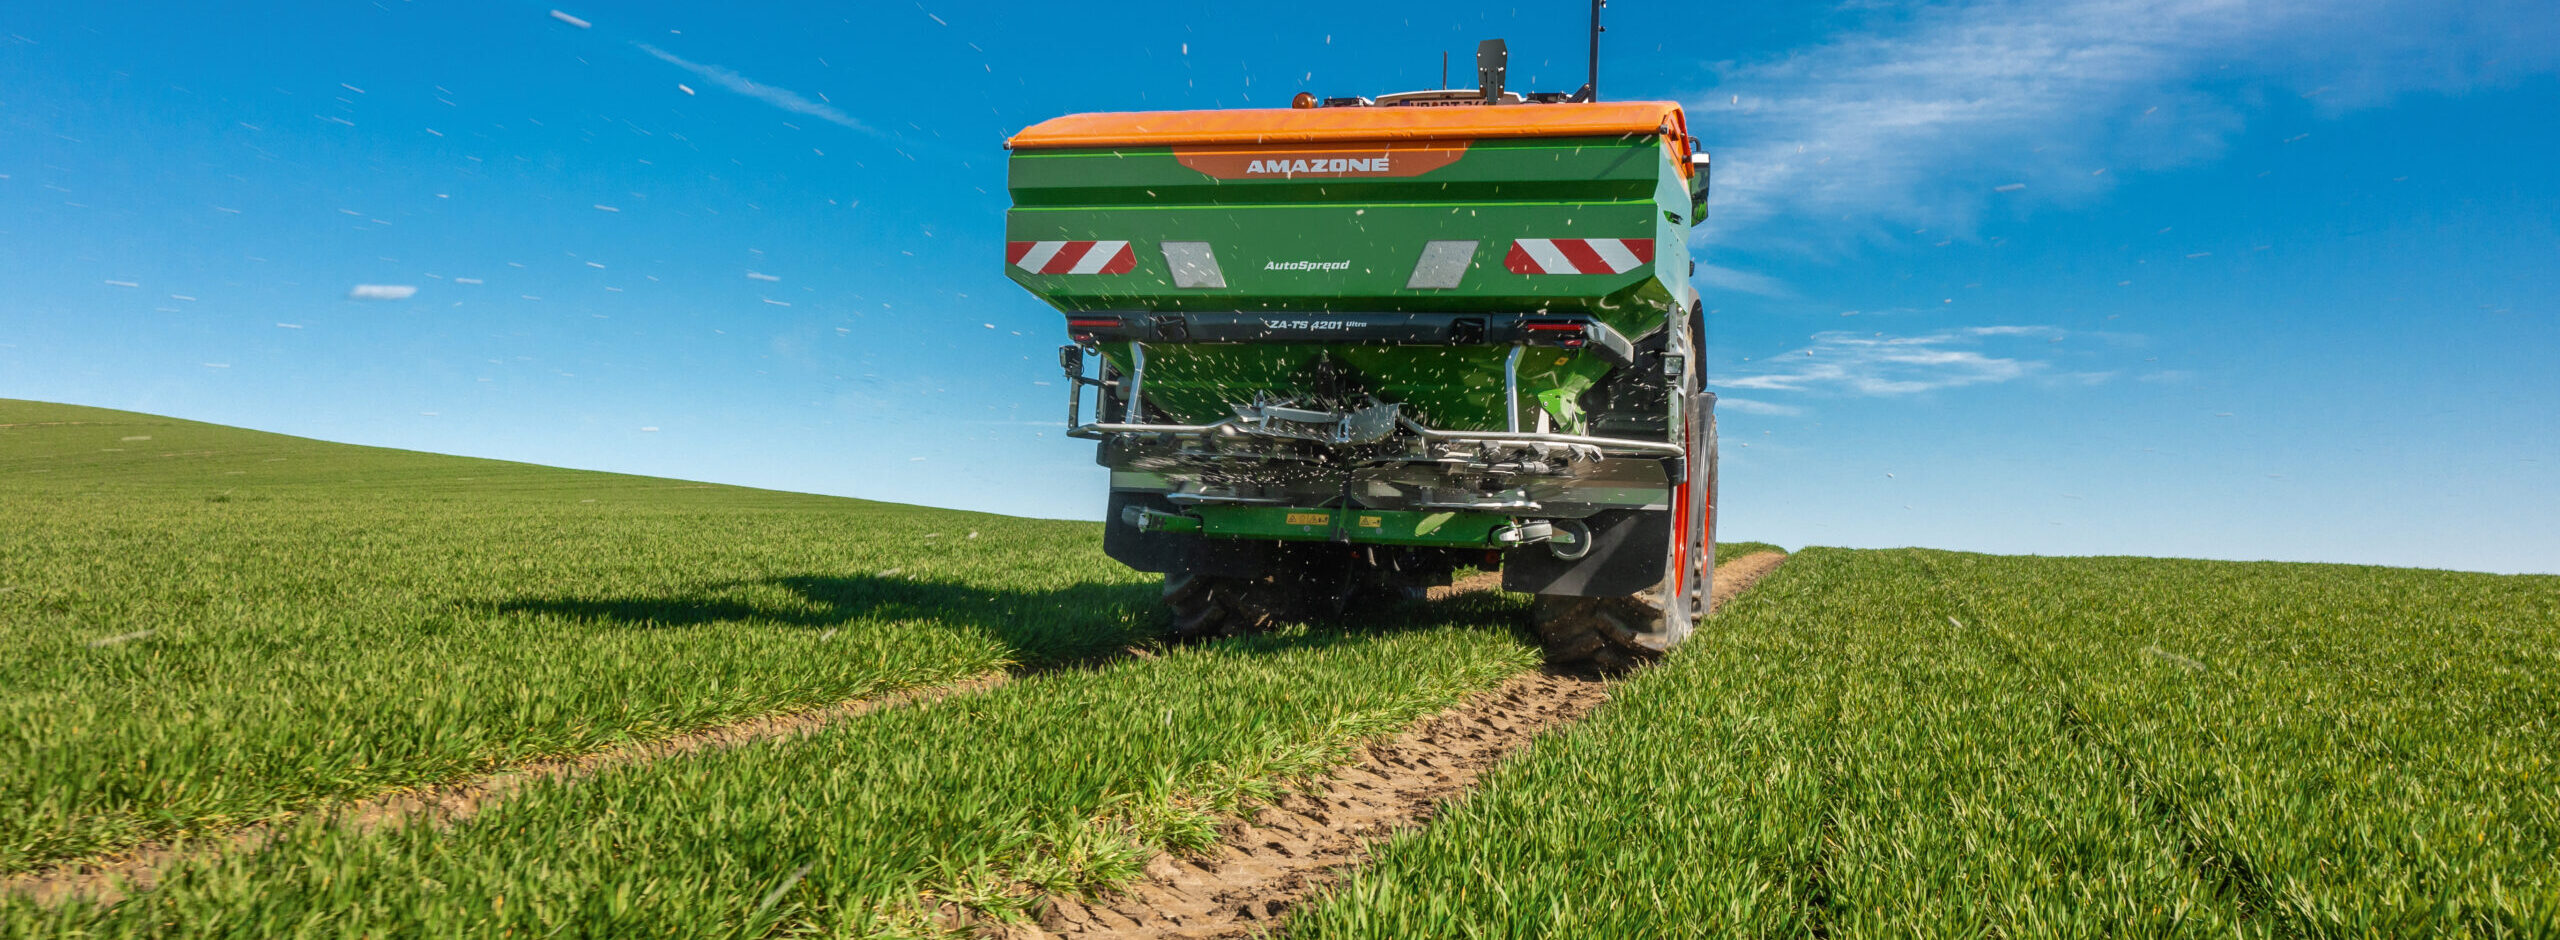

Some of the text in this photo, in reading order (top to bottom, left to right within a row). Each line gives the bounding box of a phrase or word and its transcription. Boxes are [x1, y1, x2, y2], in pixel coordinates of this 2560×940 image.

[1247, 158, 1389, 173] AMAZONE
[1264, 260, 1350, 272] AutoSpread
[1270, 320, 1308, 329] ZA-TS
[1311, 321, 1342, 330] 4201
